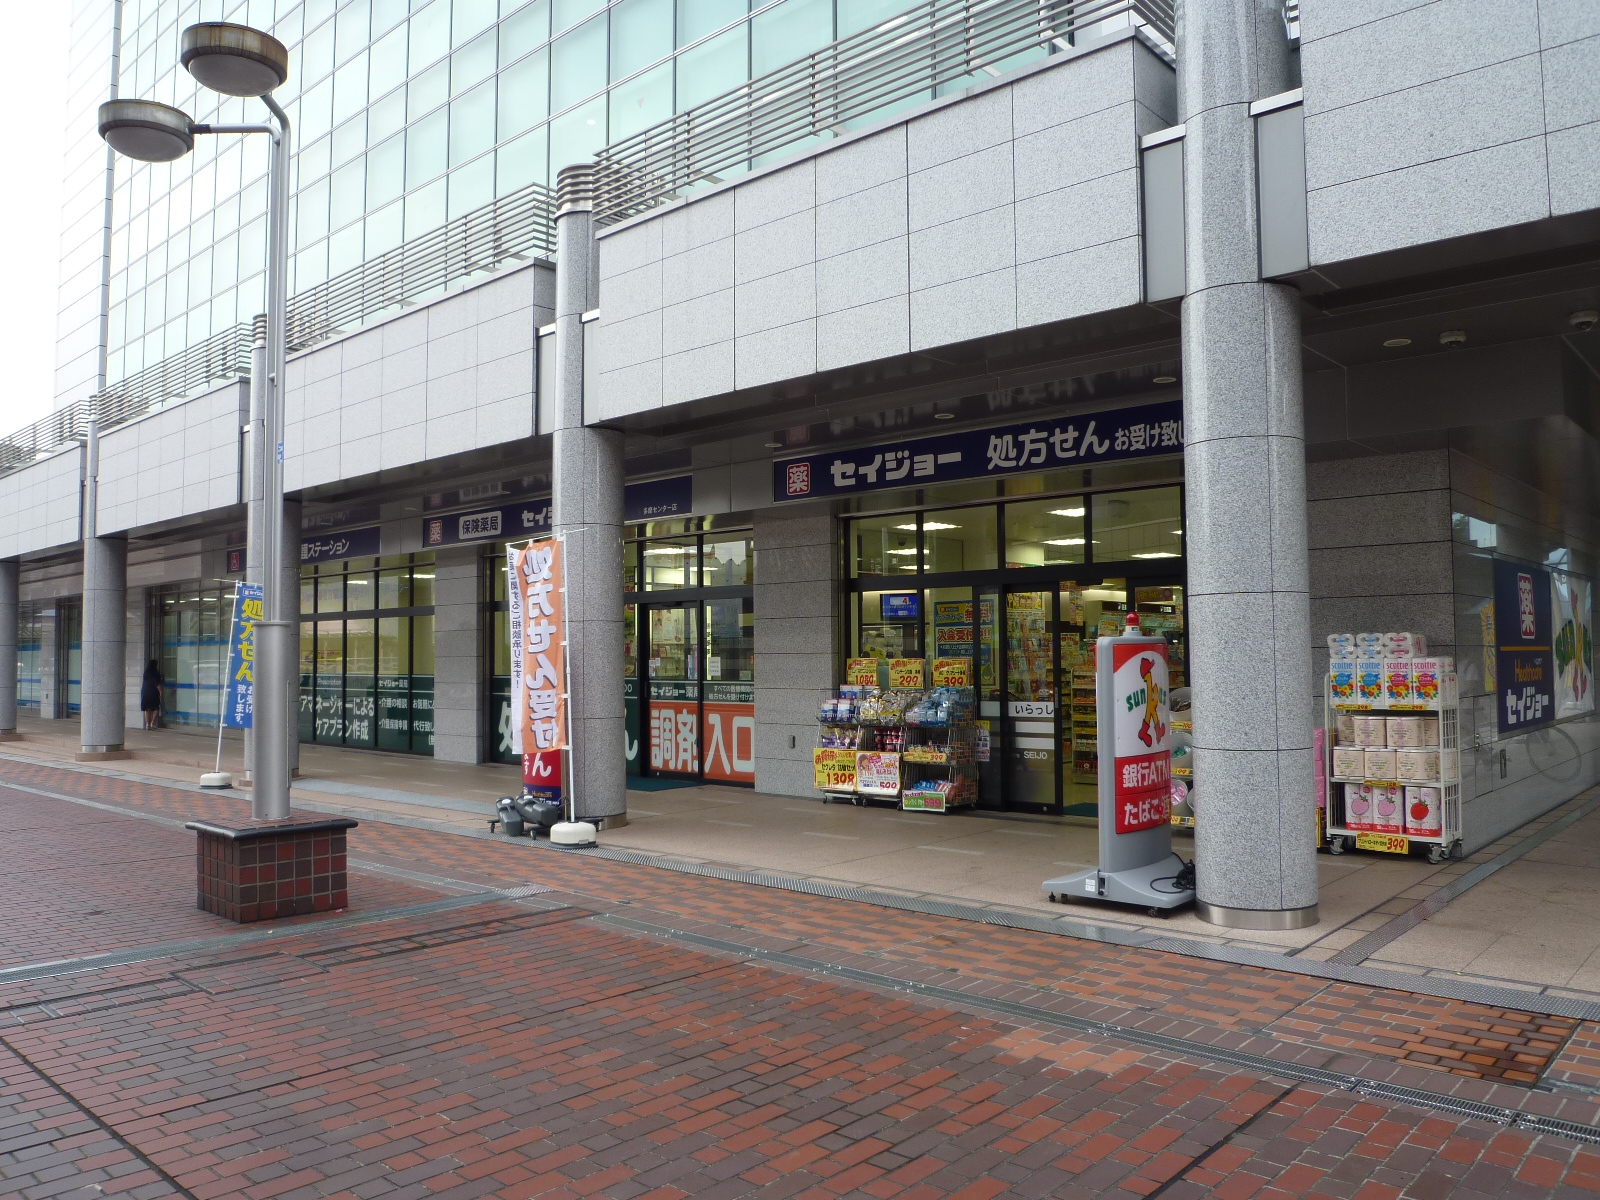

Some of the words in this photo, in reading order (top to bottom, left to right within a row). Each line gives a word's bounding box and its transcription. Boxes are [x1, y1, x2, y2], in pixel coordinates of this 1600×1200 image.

[787, 465, 809, 494] 薬
[831, 450, 962, 487] セイジョー
[987, 421, 1110, 470] 処方せん
[643, 503, 678, 516] 多摩センター店
[430, 521, 442, 542] 薬
[461, 515, 499, 535] 保険薬局
[1518, 576, 1535, 636] 薬
[899, 675, 918, 686] 299
[943, 676, 964, 686] 399
[1015, 703, 1055, 716] いらっし
[1506, 686, 1549, 725] セイジョー
[315, 717, 369, 741] ケアプラン作成
[1023, 751, 1048, 760] SEIJO
[1122, 759, 1170, 788] 銀行ATM
[1386, 837, 1405, 852] 399
